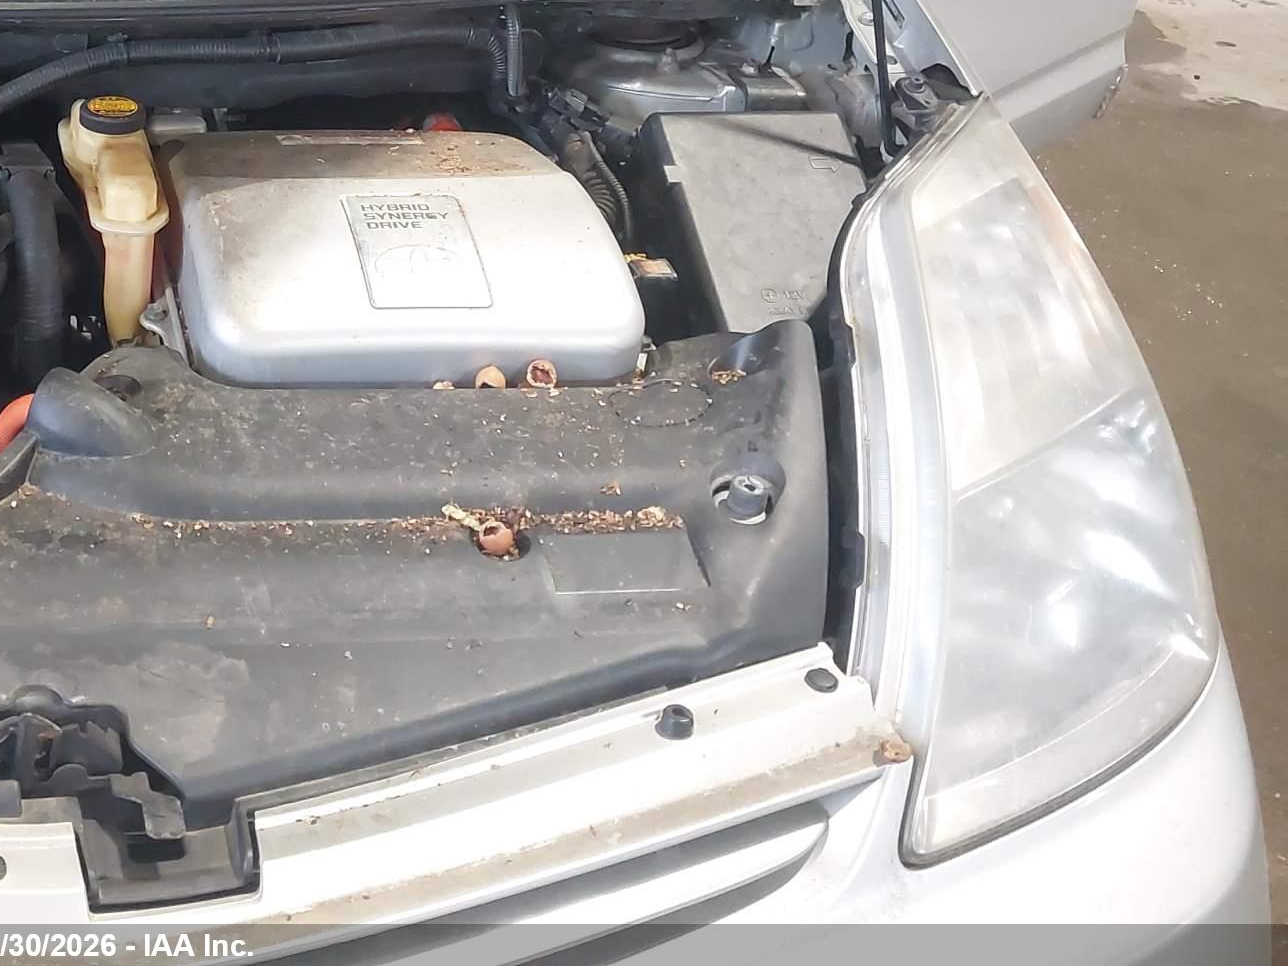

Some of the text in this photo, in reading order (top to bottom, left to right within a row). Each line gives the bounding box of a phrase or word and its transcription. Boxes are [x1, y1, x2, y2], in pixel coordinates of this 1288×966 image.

[360, 203, 430, 212] HYBRID
[363, 212, 449, 221] SYNERGY
[366, 221, 424, 230] DRIVE
